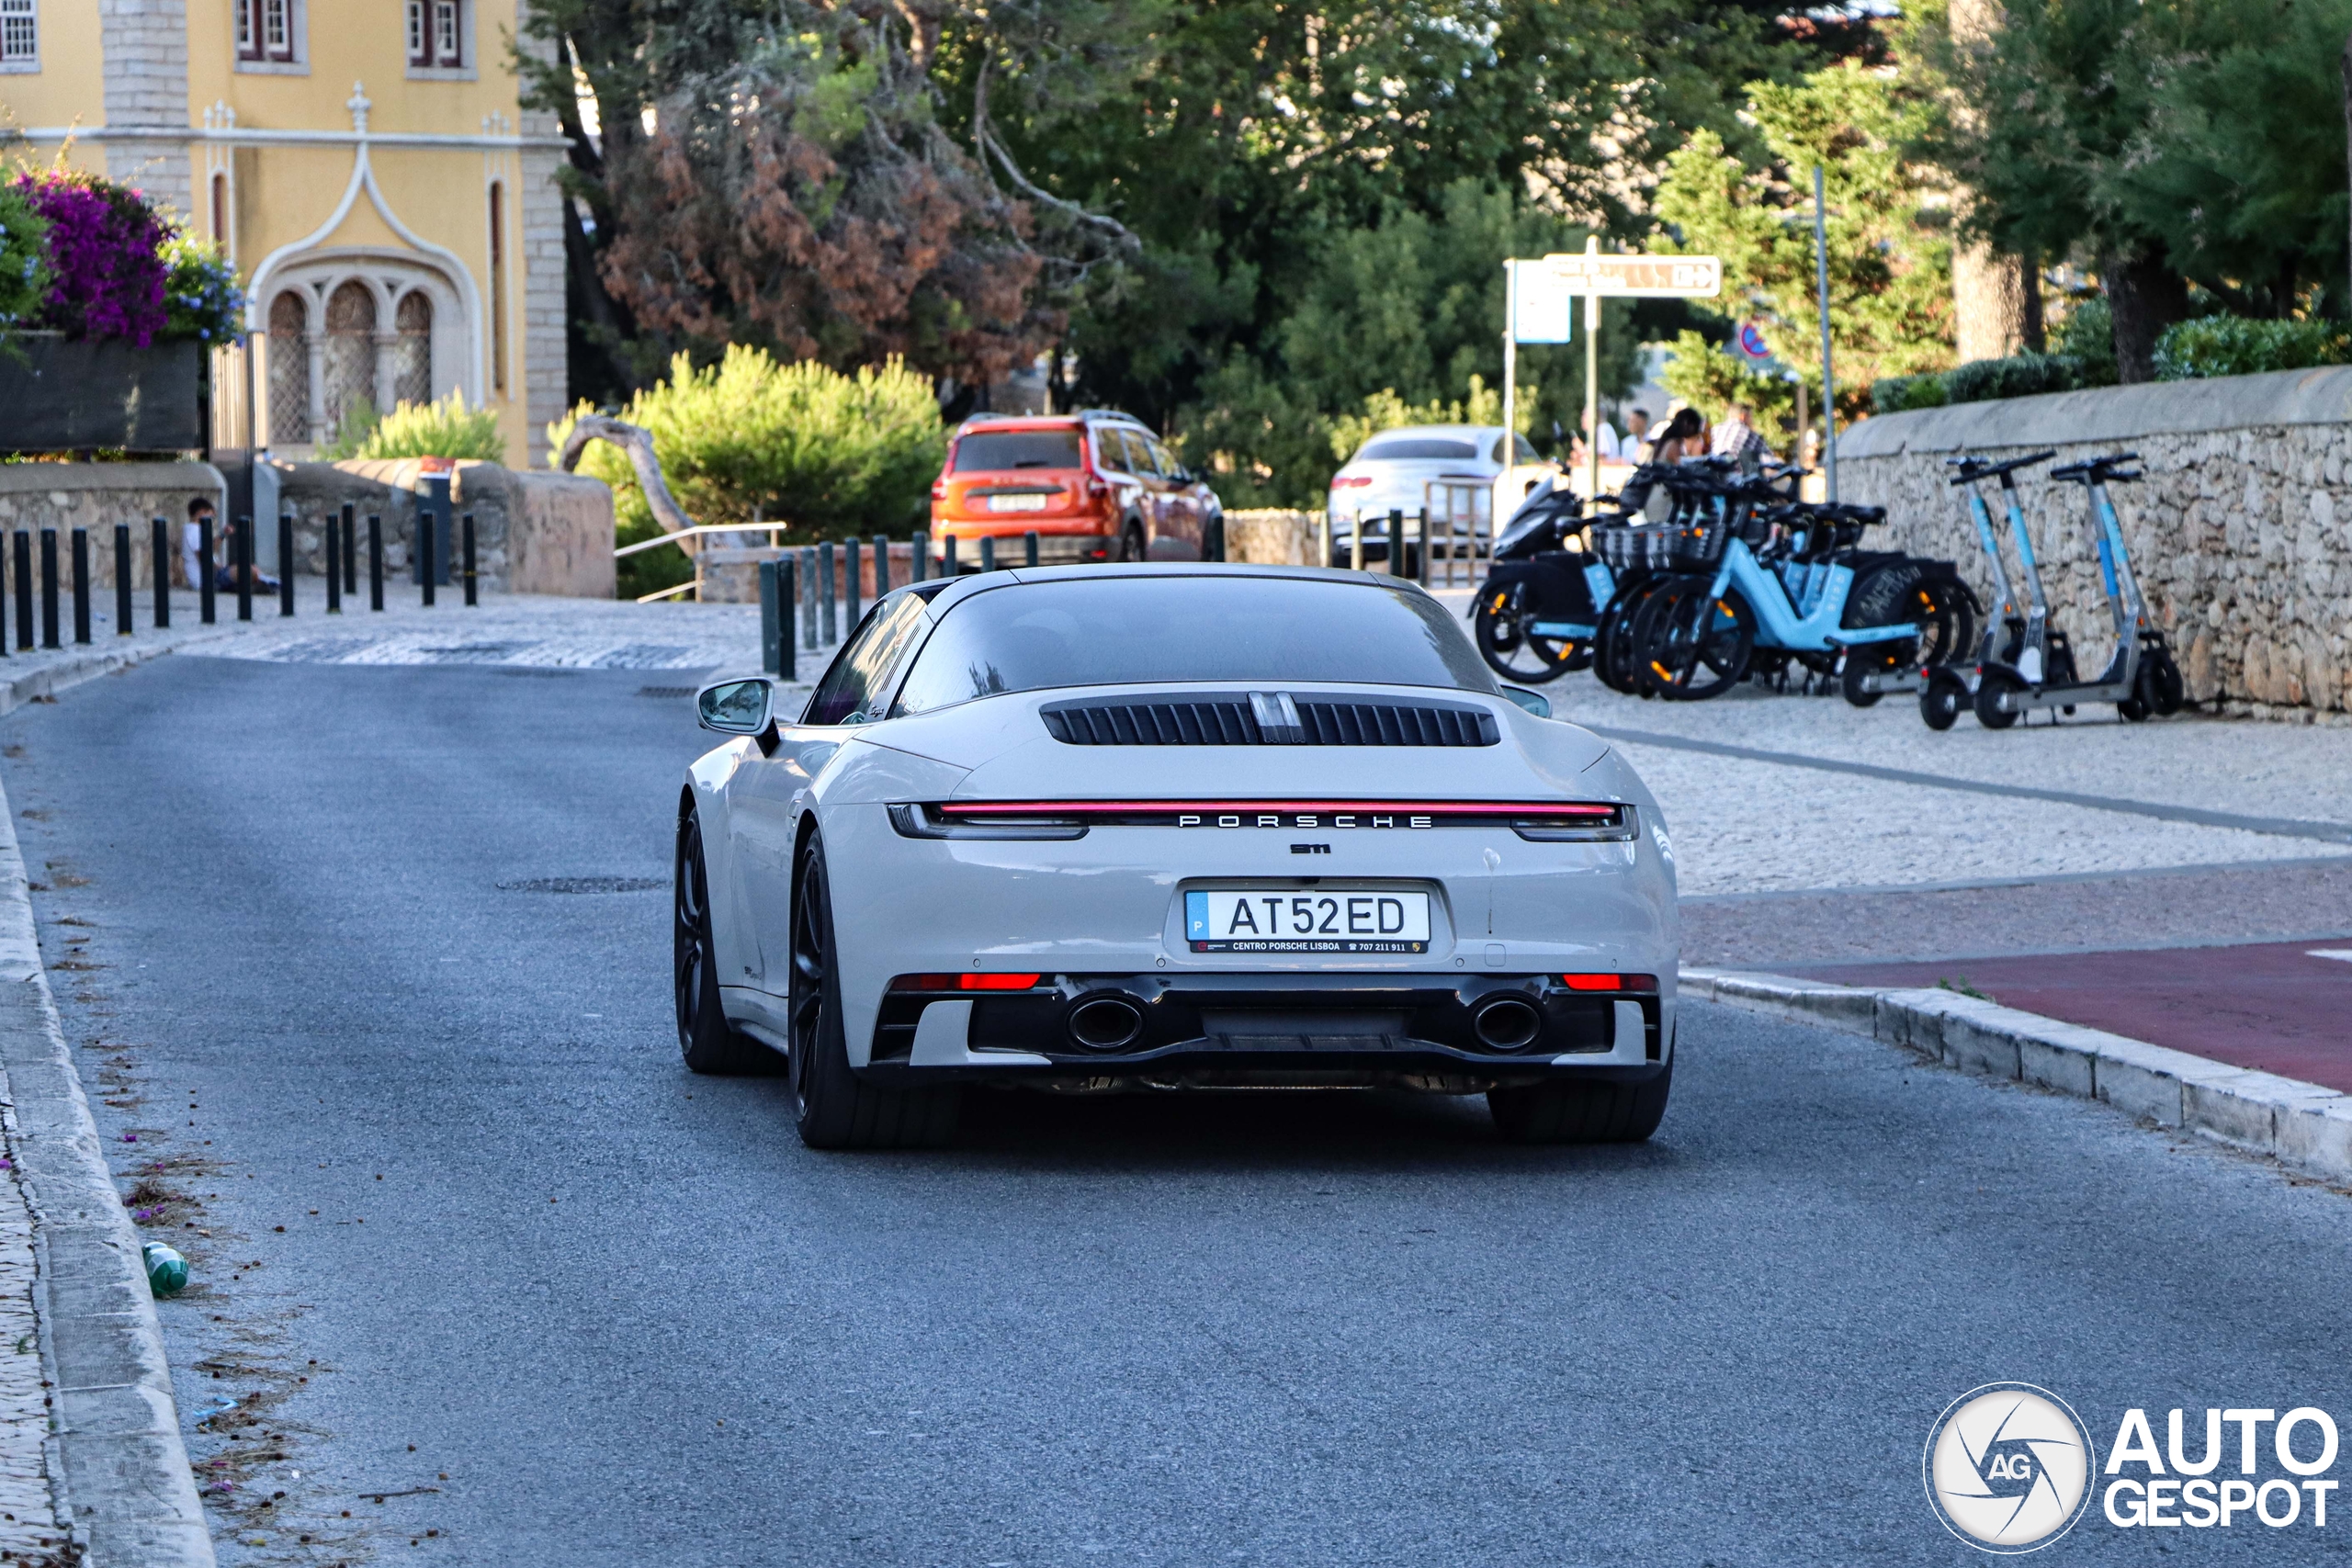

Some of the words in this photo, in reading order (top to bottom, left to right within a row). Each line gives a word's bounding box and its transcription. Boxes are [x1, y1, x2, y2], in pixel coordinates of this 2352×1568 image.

[1179, 816, 1431, 828] PORSCHE
[1290, 843, 1331, 853] 911
[1193, 920, 1204, 932] P
[1233, 942, 1267, 951] CENTRO
[1269, 942, 1308, 951] PORSCHE
[1310, 942, 1340, 951] LISBOA
[1360, 942, 1374, 952] 707
[1375, 942, 1389, 952] 211
[1391, 943, 1406, 952] 911
